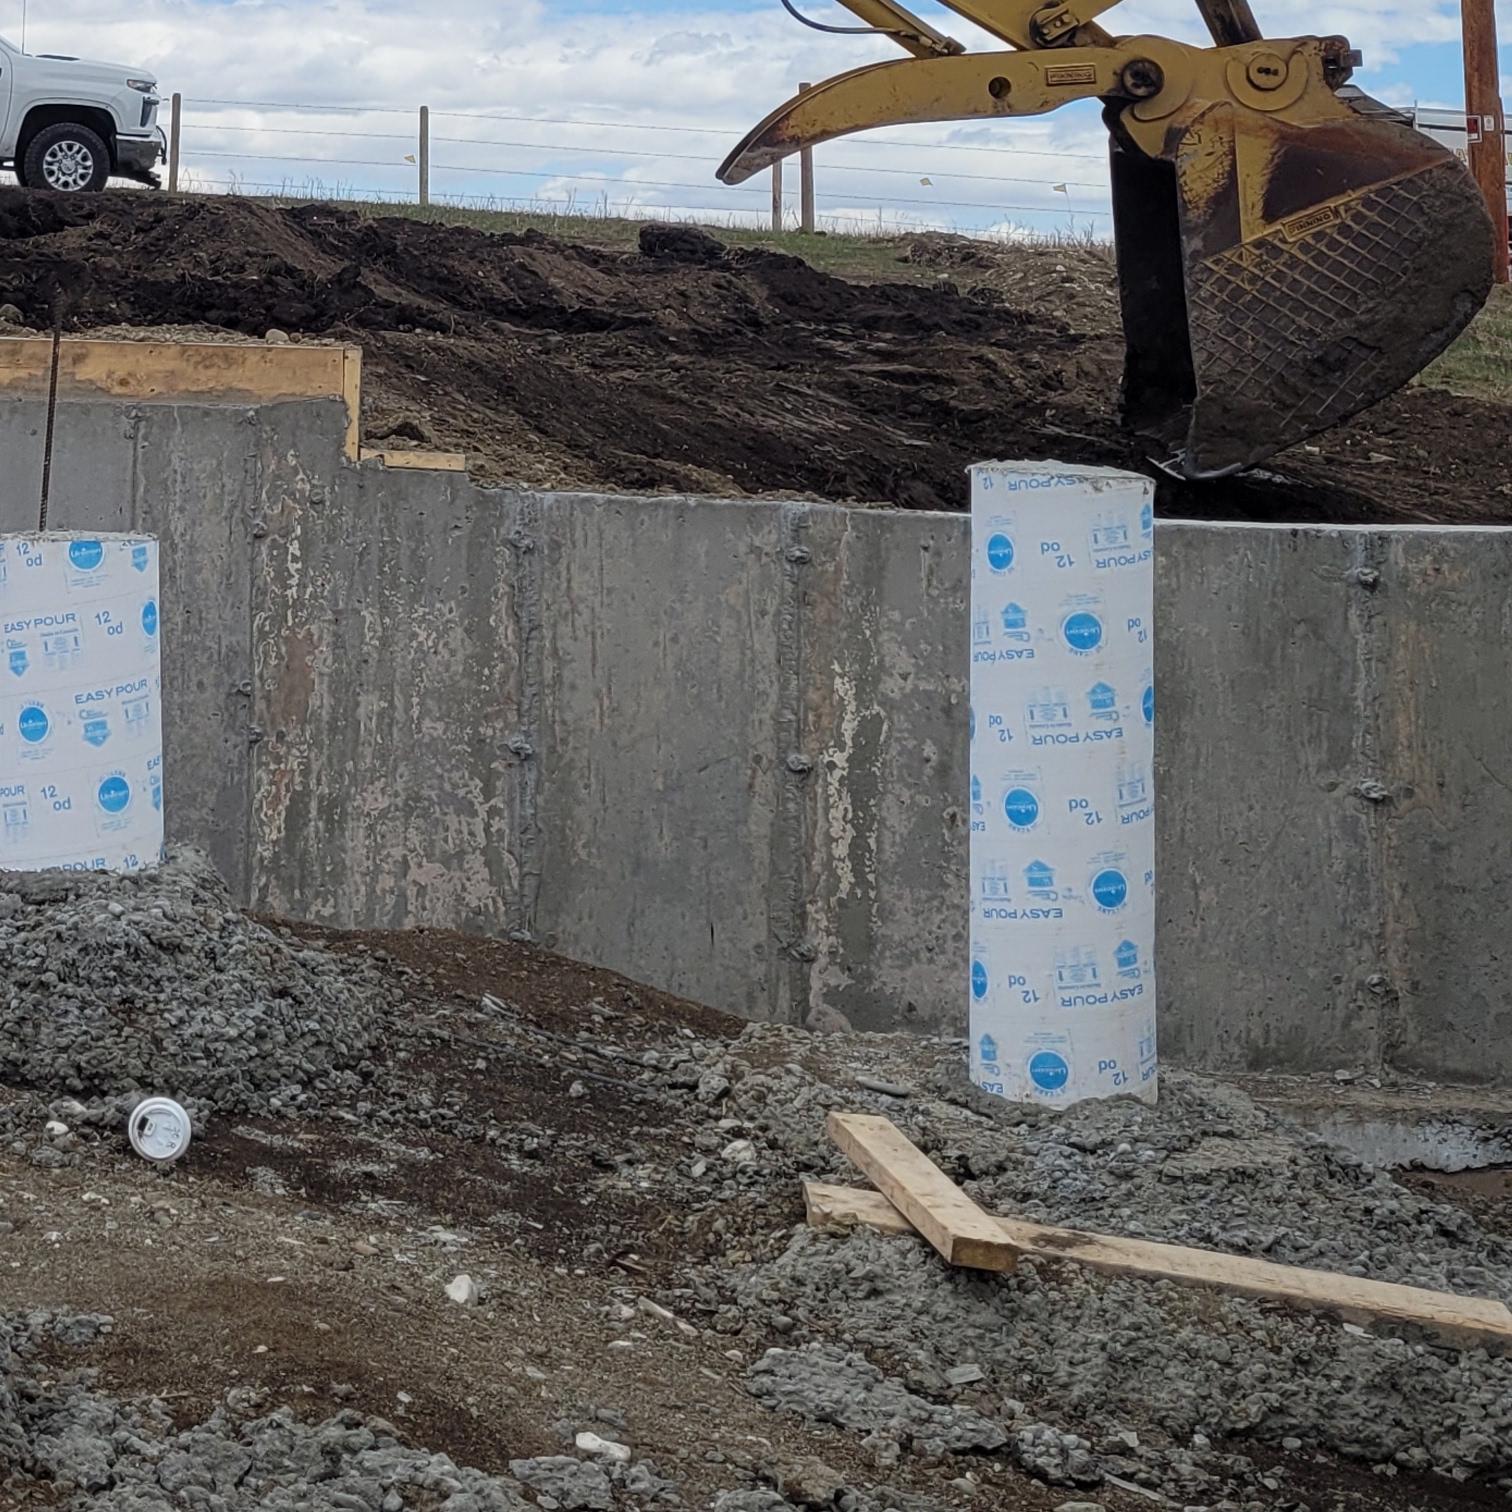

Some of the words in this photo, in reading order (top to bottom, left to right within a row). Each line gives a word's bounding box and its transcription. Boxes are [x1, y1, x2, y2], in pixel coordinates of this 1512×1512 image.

[15, 542, 30, 556] 12
[1040, 541, 1061, 555] od
[26, 554, 42, 567] od
[1055, 554, 1075, 569] 12
[34, 612, 76, 628] POUR
[94, 610, 111, 626] 12
[1127, 617, 1141, 632] od
[107, 621, 123, 636] od
[116, 679, 148, 696] POUR
[989, 714, 1002, 728] od
[998, 728, 1013, 742] 12
[1031, 731, 1080, 746] POUR
[40, 785, 58, 800] 12
[53, 796, 71, 811] od
[1068, 798, 1089, 812] od
[1084, 810, 1103, 826] 12
[123, 854, 138, 869] 12
[983, 907, 1018, 920] POUR
[1008, 974, 1026, 988] od
[1021, 989, 1041, 1004] 12
[1060, 992, 1108, 1007] POUR
[1098, 1060, 1117, 1075] od
[1112, 1070, 1129, 1086] 12
